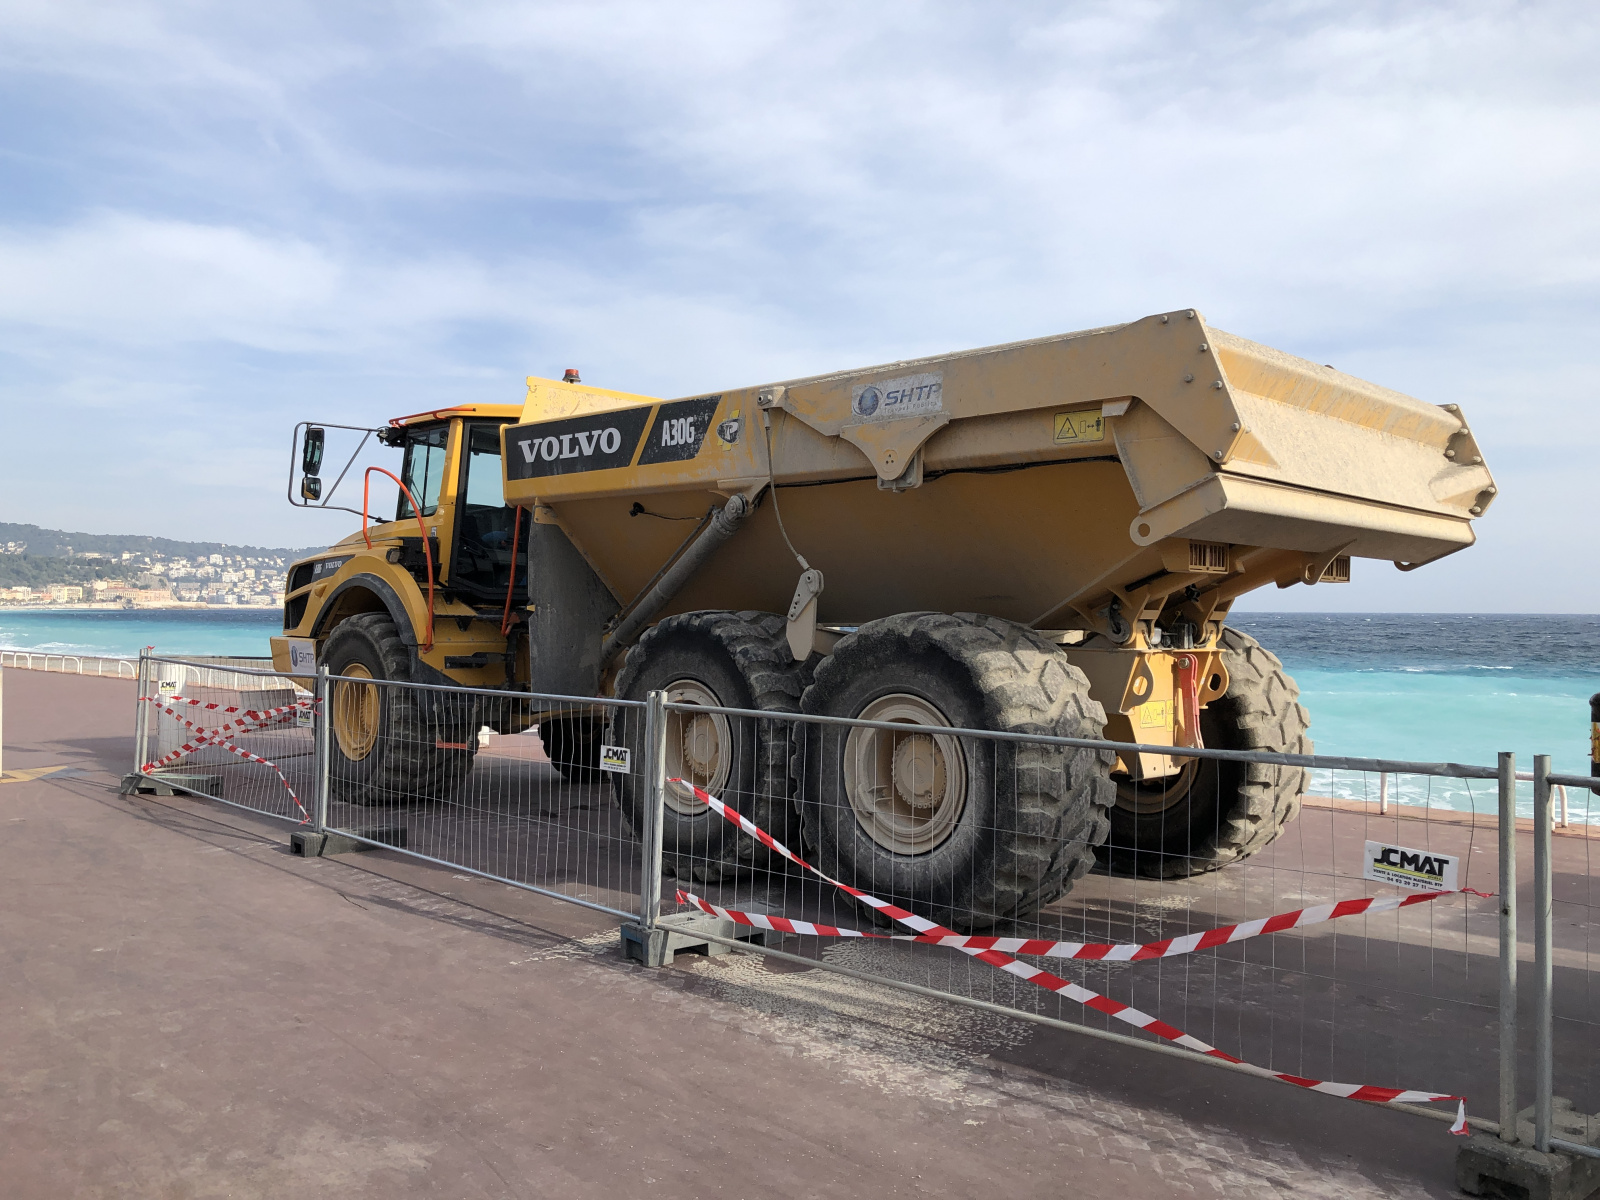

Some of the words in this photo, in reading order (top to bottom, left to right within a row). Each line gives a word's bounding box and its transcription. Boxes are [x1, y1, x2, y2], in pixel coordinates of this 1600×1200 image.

[518, 427, 622, 463] VOLVO
[661, 416, 695, 447] A30G
[298, 652, 315, 663] SHTP
[1373, 847, 1449, 877] JCMAT
